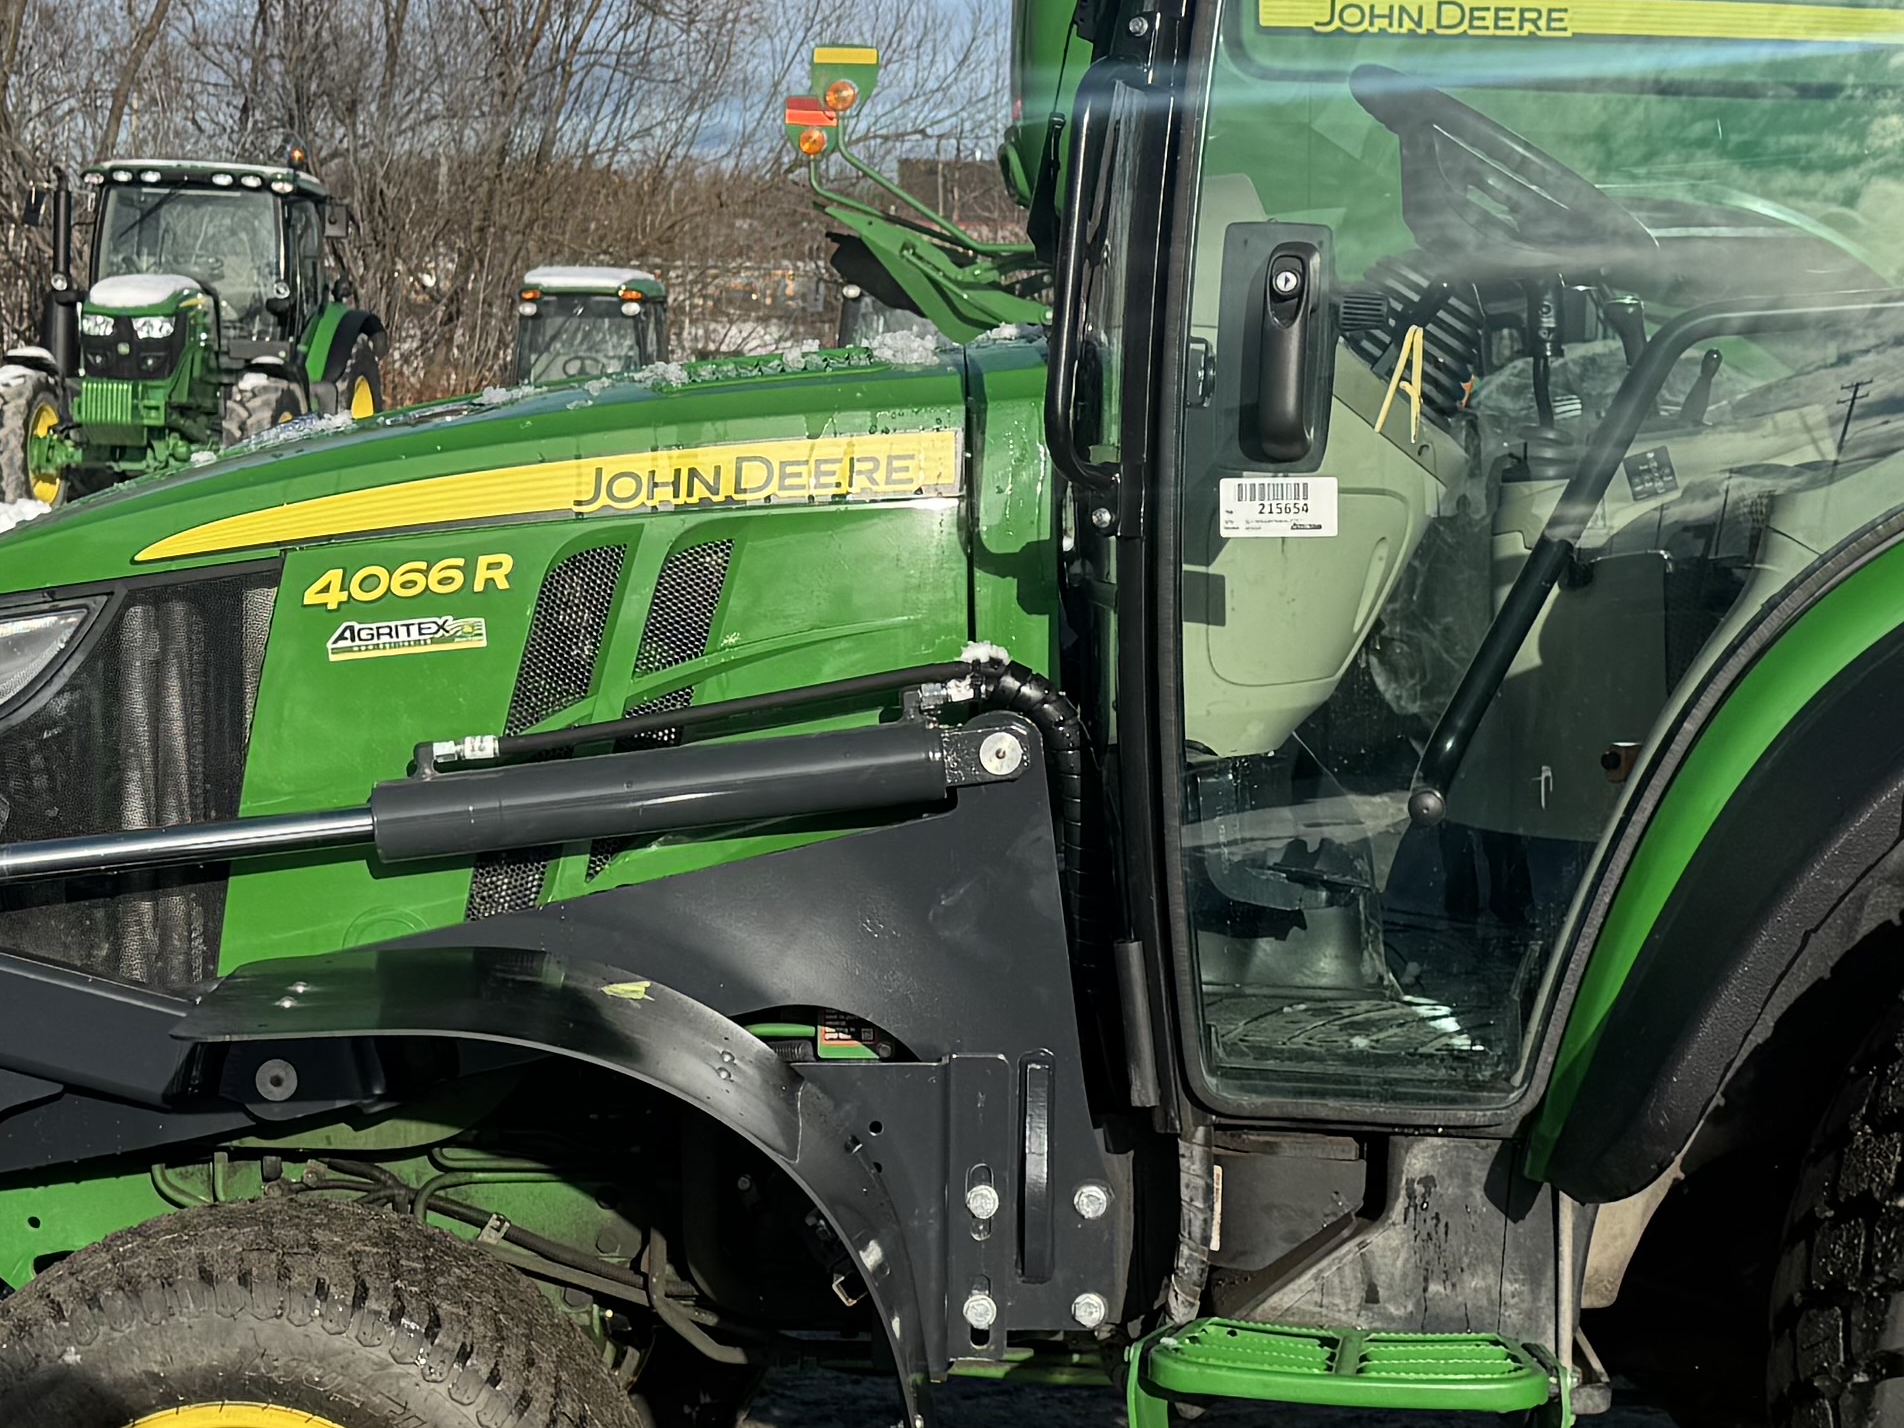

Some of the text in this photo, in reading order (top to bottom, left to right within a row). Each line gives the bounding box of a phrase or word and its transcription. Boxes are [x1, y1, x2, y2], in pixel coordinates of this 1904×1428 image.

[1437, 0, 1569, 32] DEERE
[574, 453, 916, 507] JOHN DEERE
[1258, 503, 1309, 515] 215654
[332, 619, 450, 645] AGRITEX
